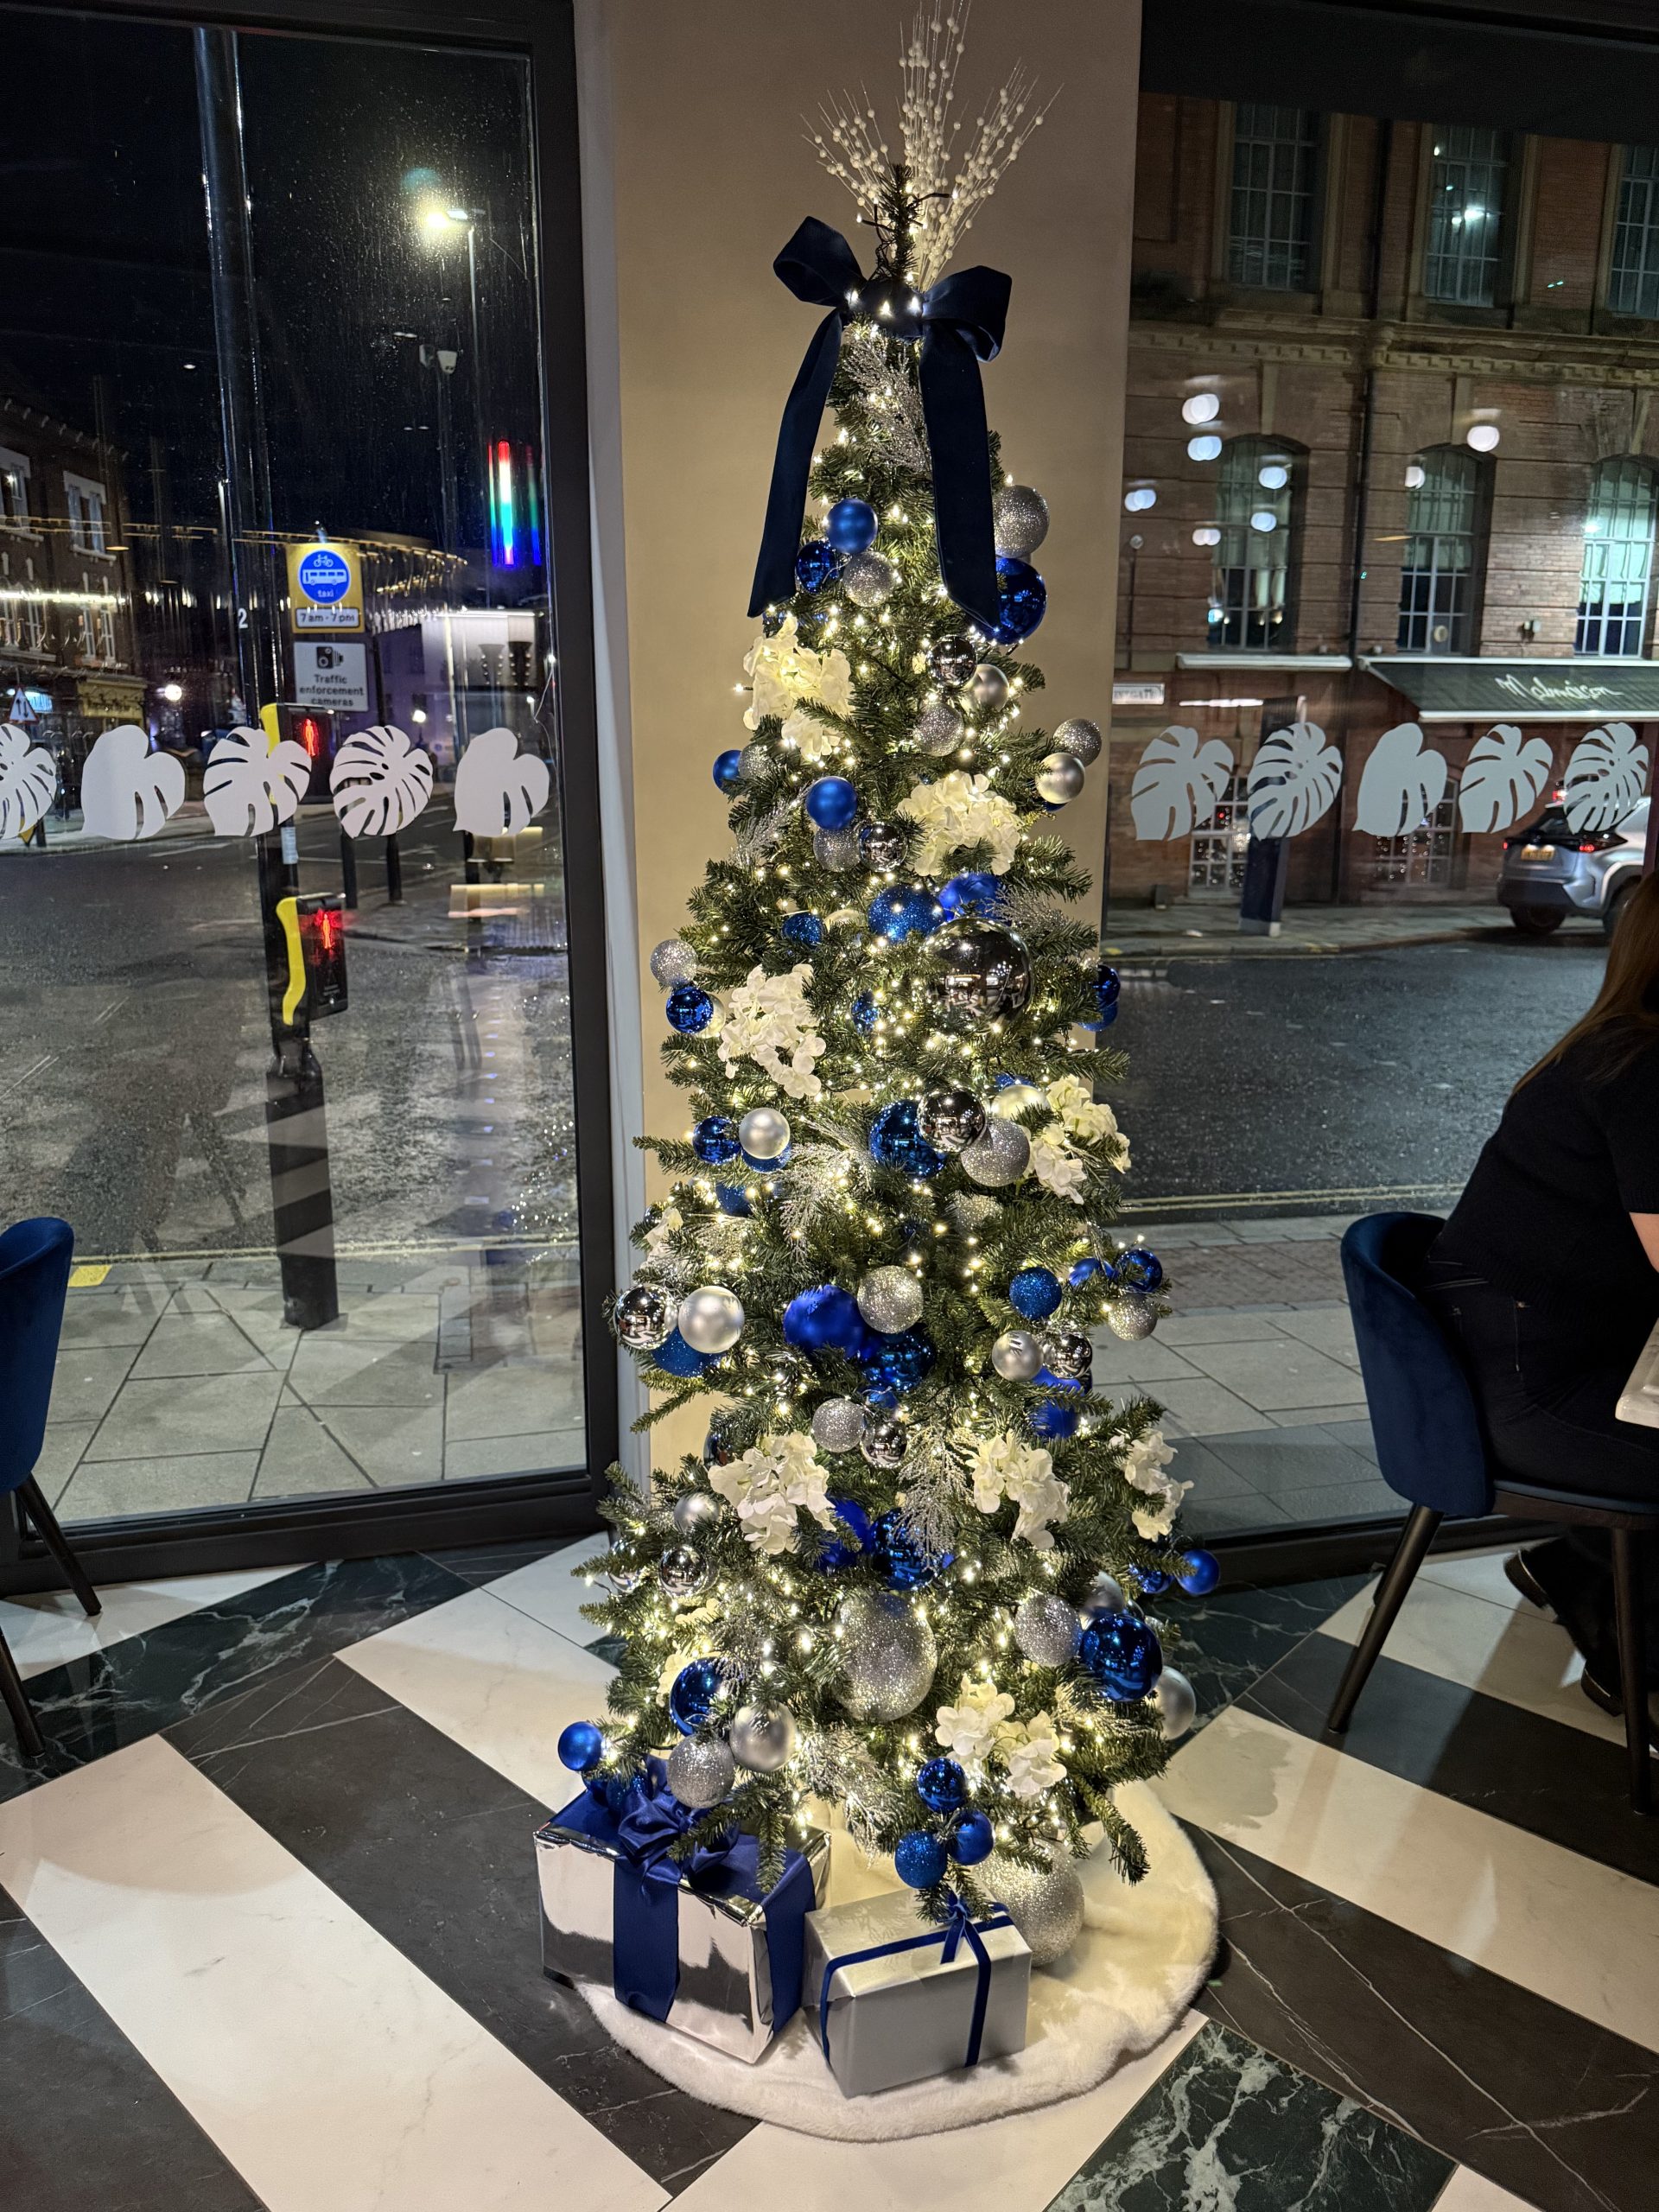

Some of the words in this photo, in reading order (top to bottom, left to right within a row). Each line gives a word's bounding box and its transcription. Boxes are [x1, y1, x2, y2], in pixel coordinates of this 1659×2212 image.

[317, 589, 334, 598] taxi
[238, 607, 248, 628] 2
[314, 674, 347, 684] Traffic
[299, 685, 365, 696] enforcement
[1495, 673, 1624, 702] Malmaison
[311, 697, 354, 707] cameras
